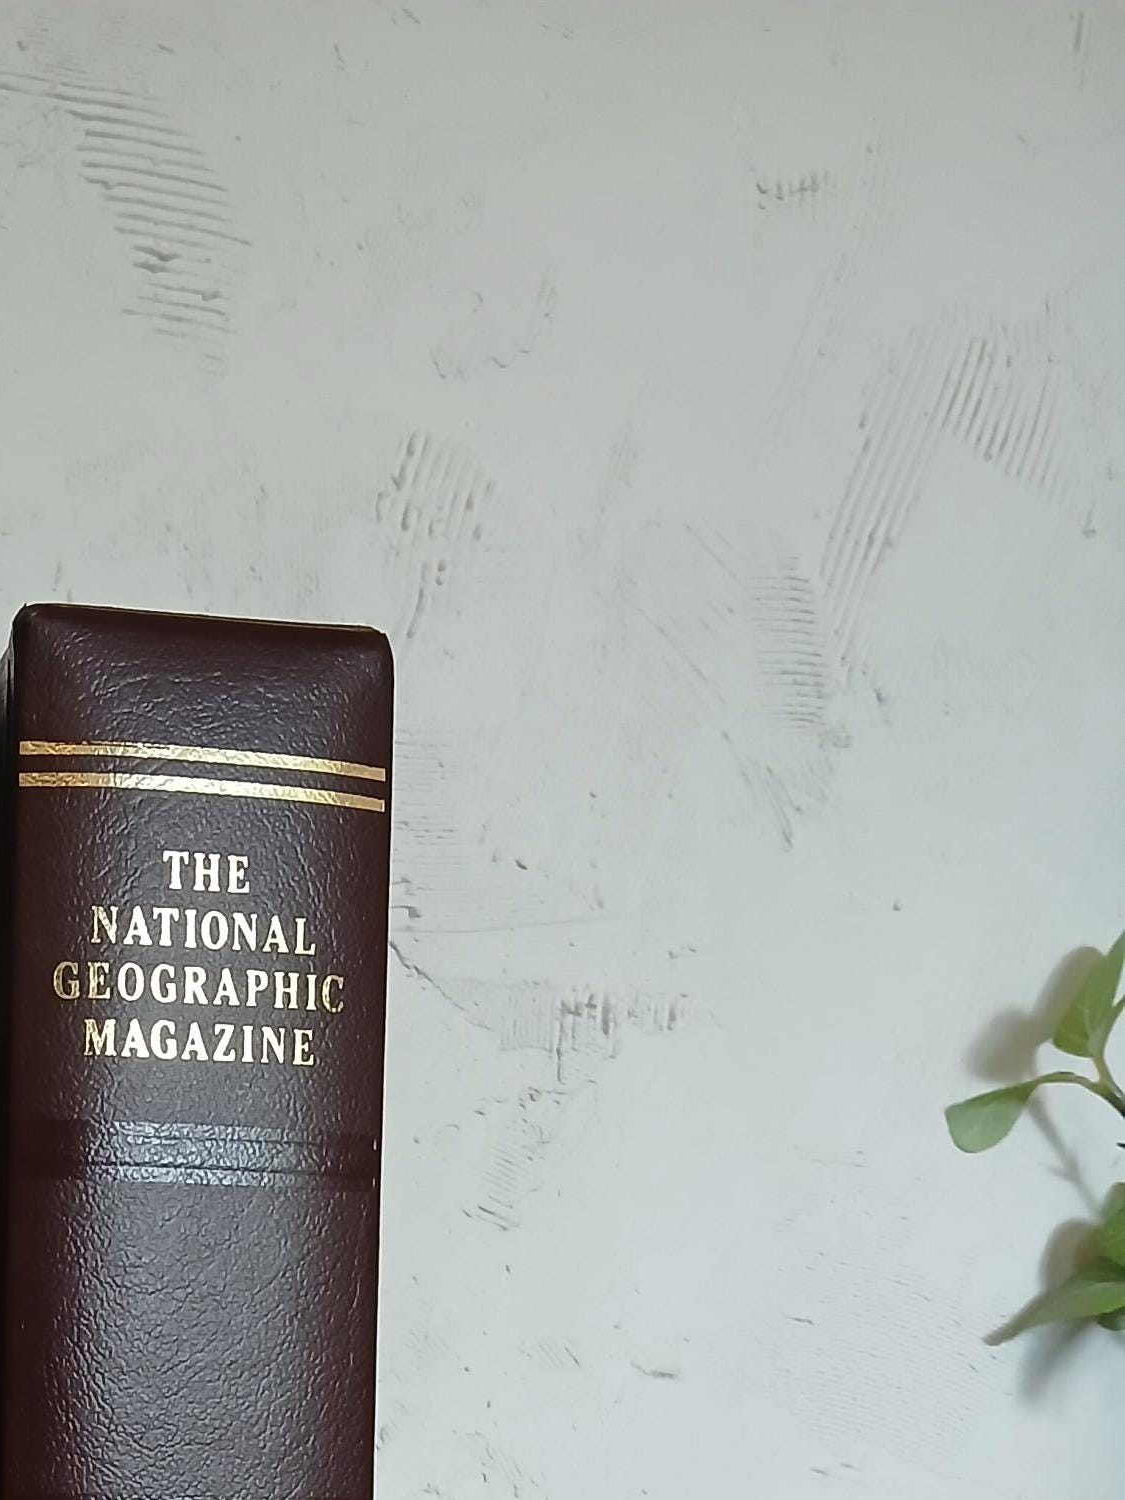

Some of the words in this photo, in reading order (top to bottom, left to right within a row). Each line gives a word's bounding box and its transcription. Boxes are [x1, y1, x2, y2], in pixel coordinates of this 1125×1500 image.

[162, 850, 250, 895] THE
[91, 905, 316, 956] NATIONAL
[53, 960, 344, 1013] GEOGRAPHIC
[83, 1018, 315, 1067] MAGAZINE
